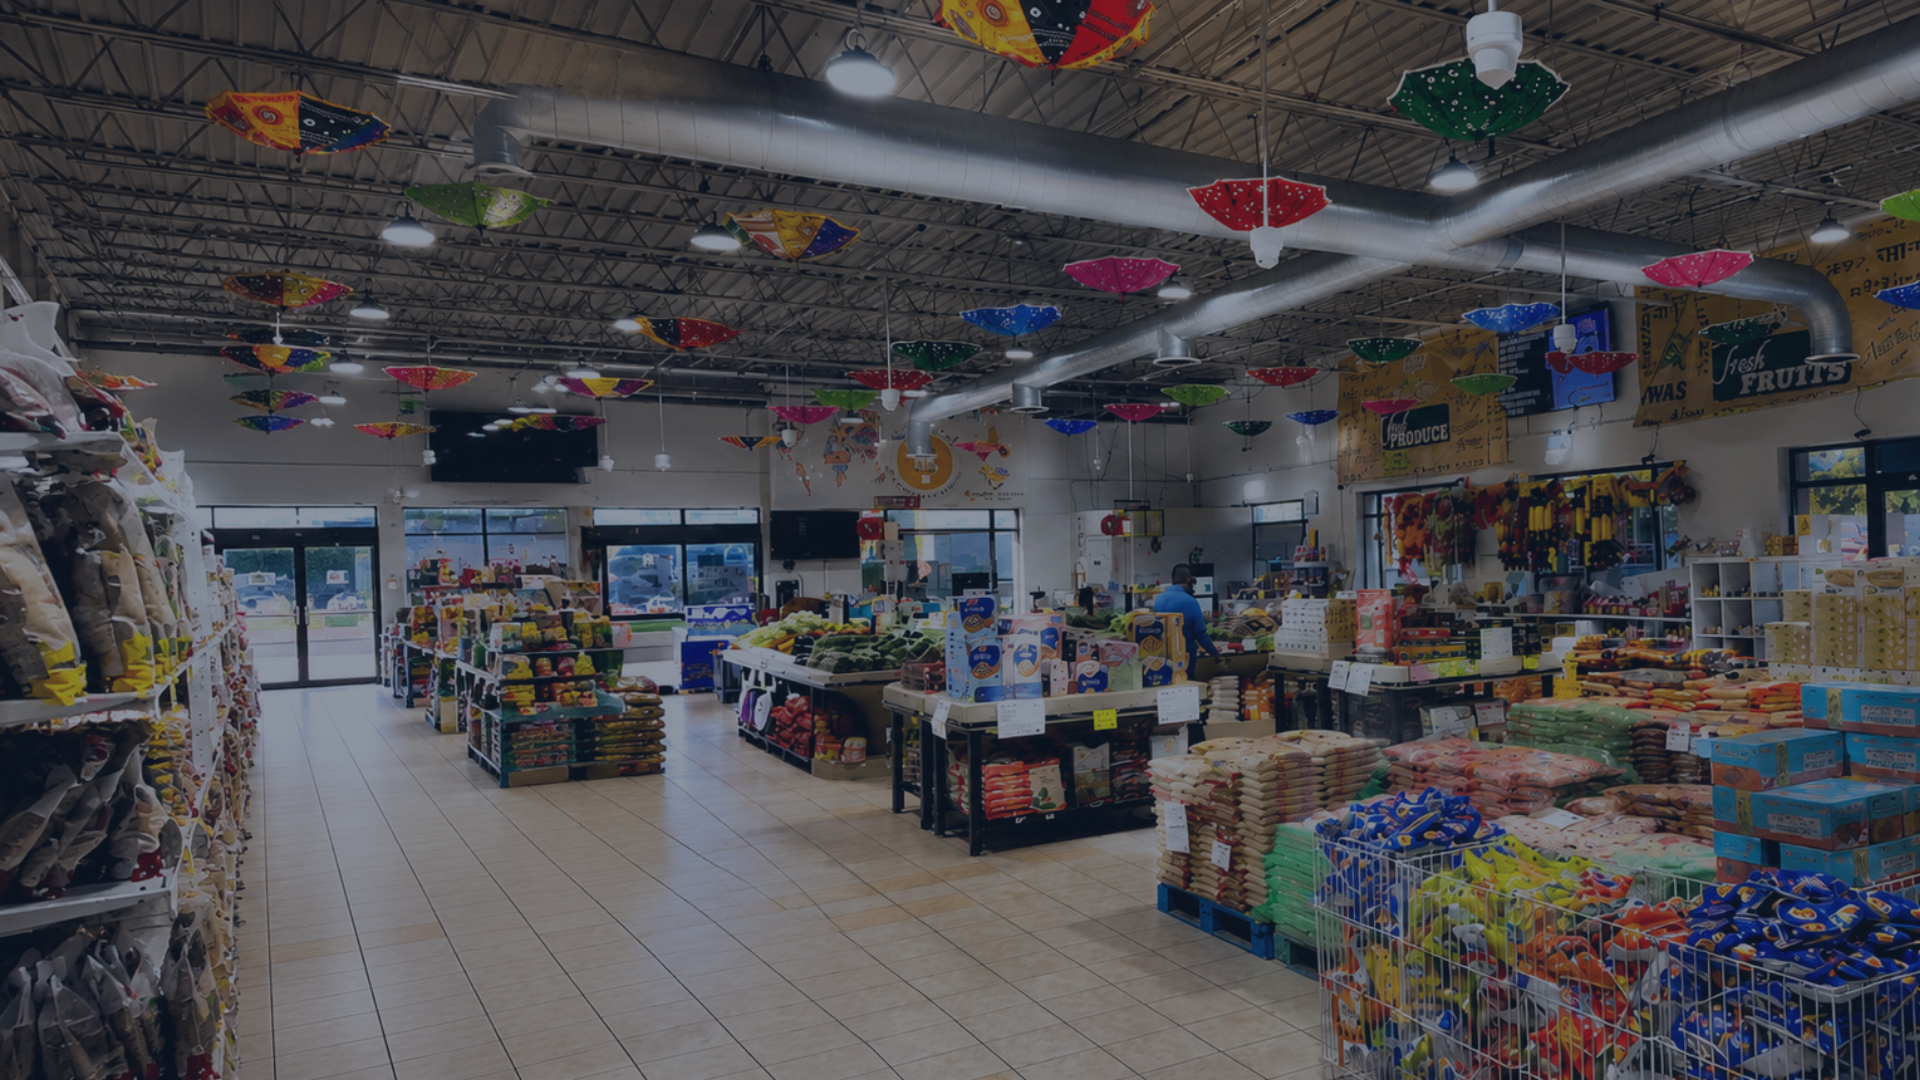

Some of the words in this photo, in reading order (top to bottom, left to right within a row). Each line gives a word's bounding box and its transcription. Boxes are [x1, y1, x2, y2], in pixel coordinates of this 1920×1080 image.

[1739, 363, 1847, 395] FRUITS
[1646, 381, 1687, 405] WAS
[1390, 423, 1449, 449] PRODUCE
